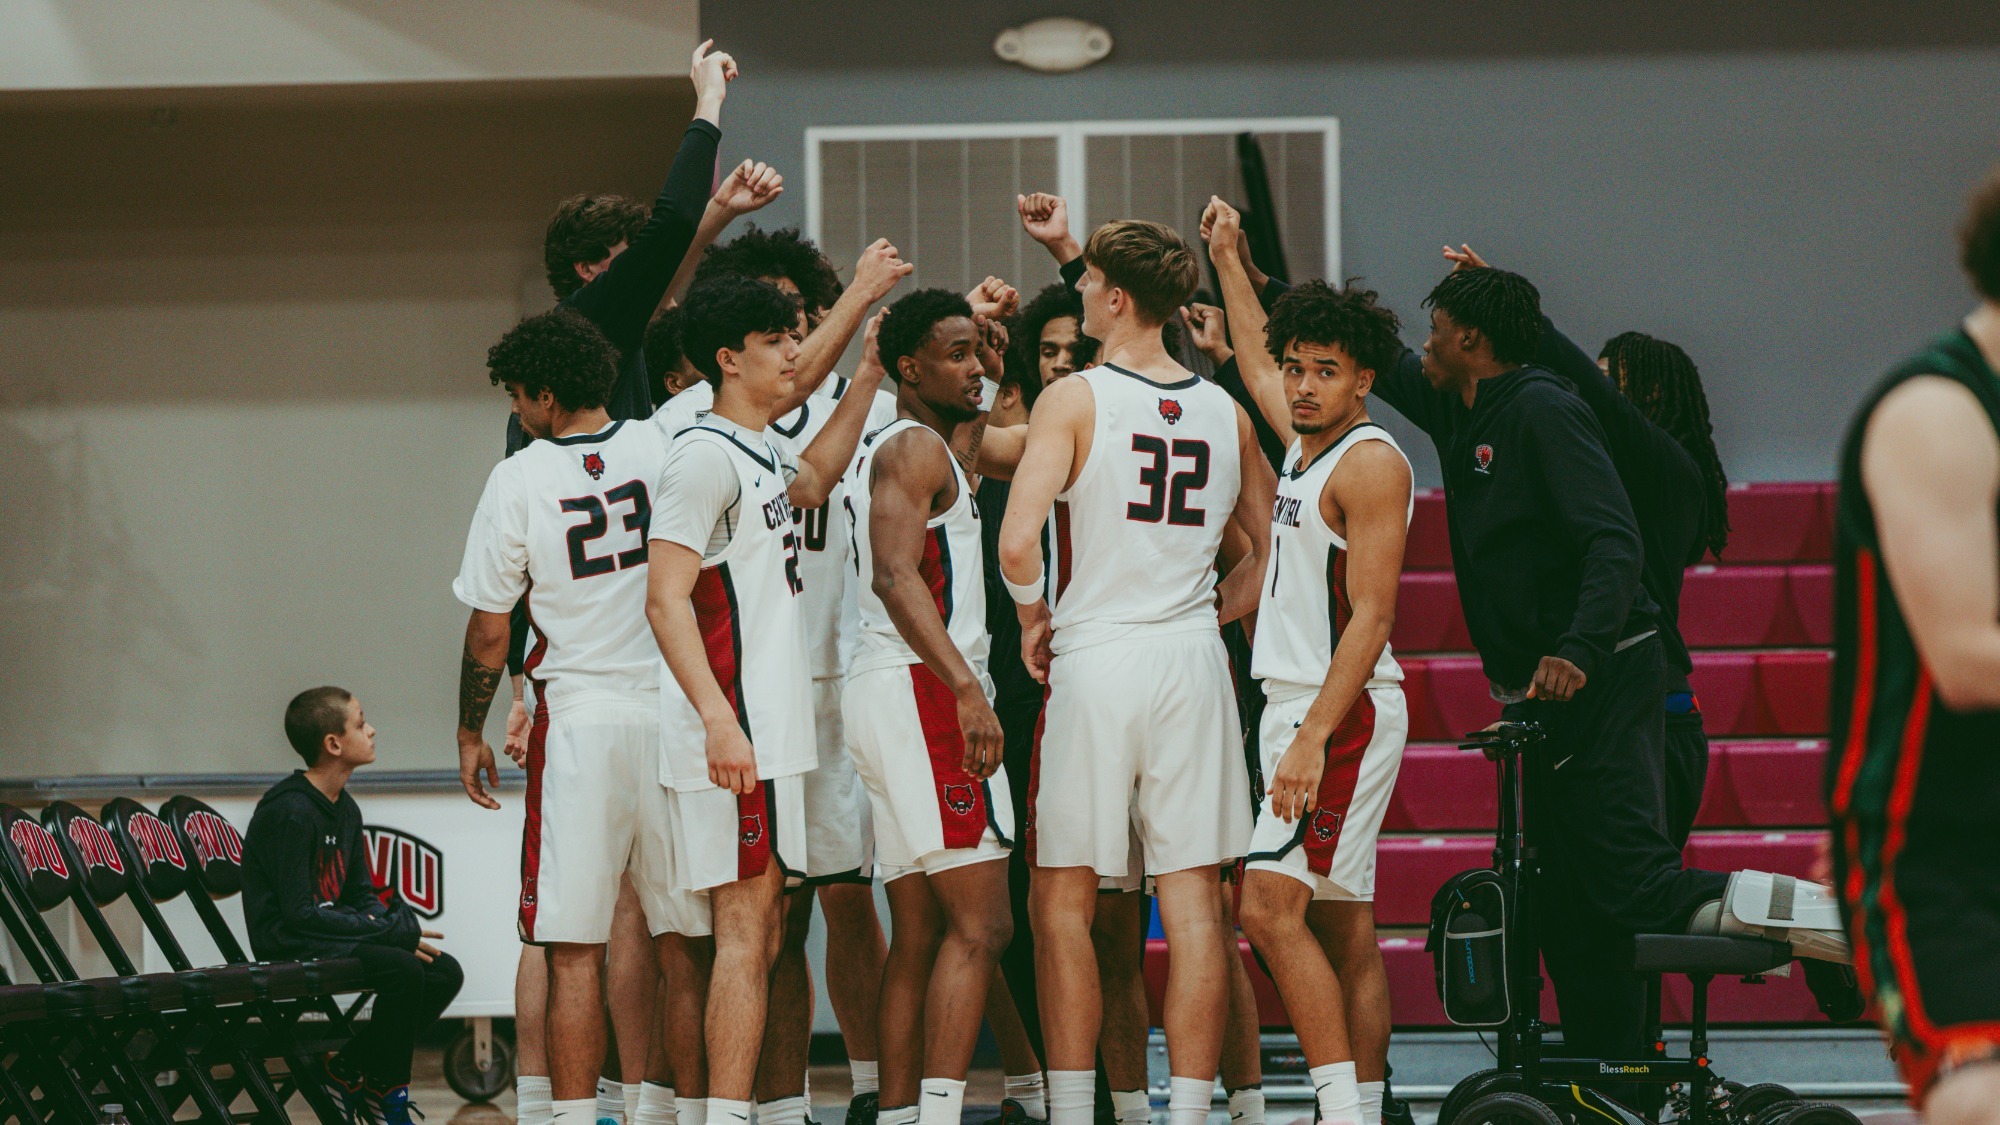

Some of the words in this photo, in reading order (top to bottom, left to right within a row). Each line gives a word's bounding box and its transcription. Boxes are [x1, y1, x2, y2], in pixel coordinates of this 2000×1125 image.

[1126, 433, 1211, 527] 32
[559, 479, 652, 580] 23
[128, 811, 187, 875] CWU
[1599, 1062, 1650, 1074] BlessReach
